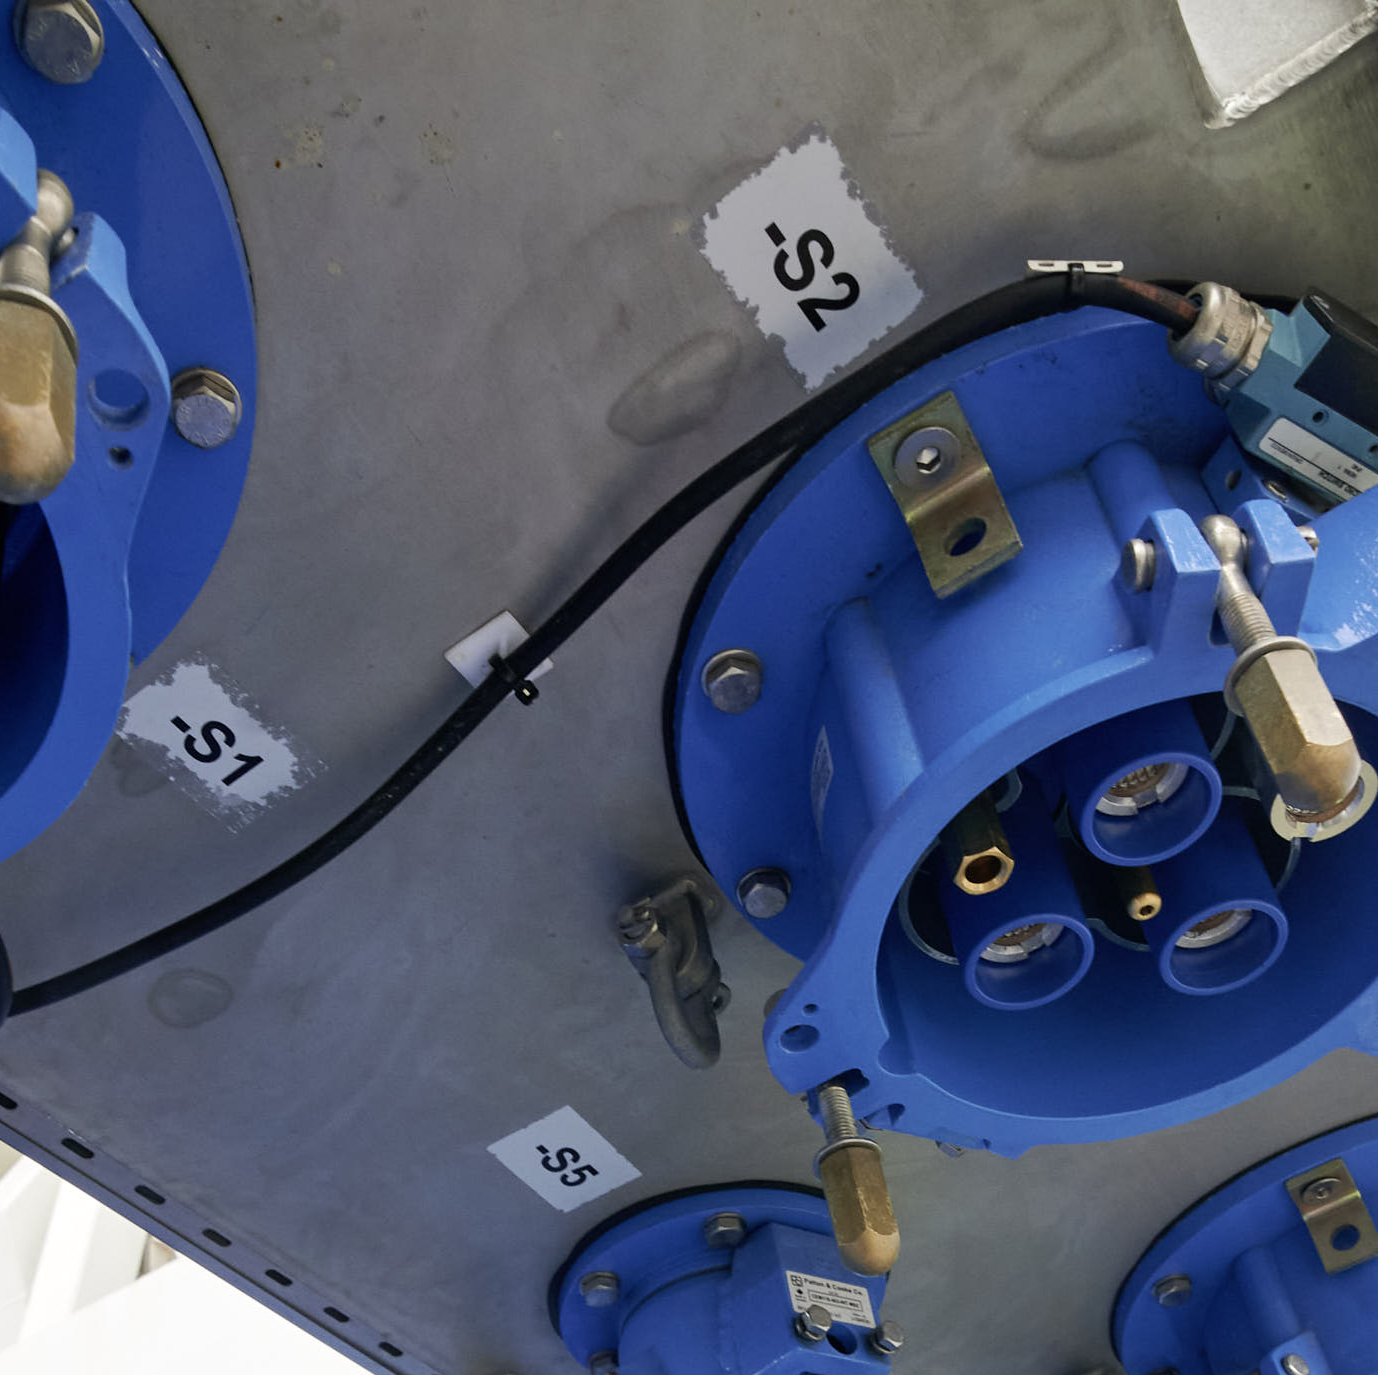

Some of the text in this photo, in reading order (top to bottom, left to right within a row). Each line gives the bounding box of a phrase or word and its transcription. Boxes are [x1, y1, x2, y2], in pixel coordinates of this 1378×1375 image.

[764, 221, 861, 333] -S2
[170, 715, 265, 787] -S1
[535, 1144, 600, 1188] -S5
